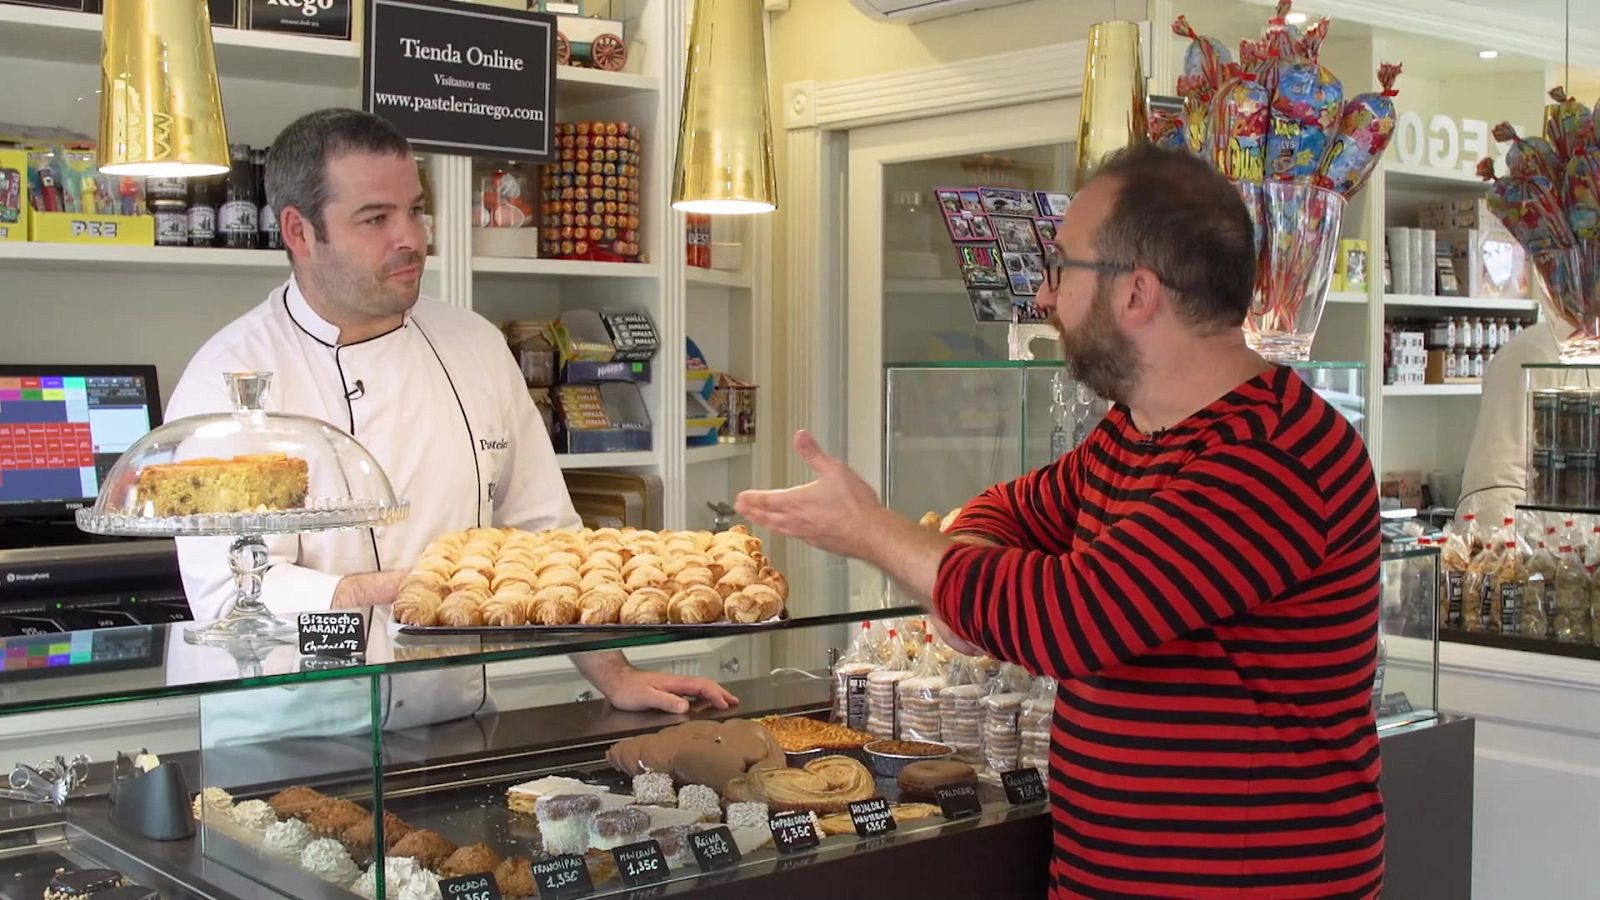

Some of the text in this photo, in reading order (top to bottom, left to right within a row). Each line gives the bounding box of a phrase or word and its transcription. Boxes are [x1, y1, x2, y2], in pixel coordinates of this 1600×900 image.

[400, 37, 524, 71] Tienda Online
[433, 73, 491, 91] Visítanos en:
[375, 91, 544, 121] www.pasteleriarego.com
[70, 220, 118, 237] PEZ
[16, 572, 50, 582] StrongPoint
[300, 613, 360, 626] Bizcocho
[302, 624, 356, 634] NARANJA
[781, 825, 811, 843] 1,35€
[619, 846, 657, 861] MANZANA
[703, 841, 730, 859] 1,35€
[627, 858, 659, 876] 1,35€
[448, 878, 489, 893] COCADA
[546, 870, 580, 888] 1,35€
